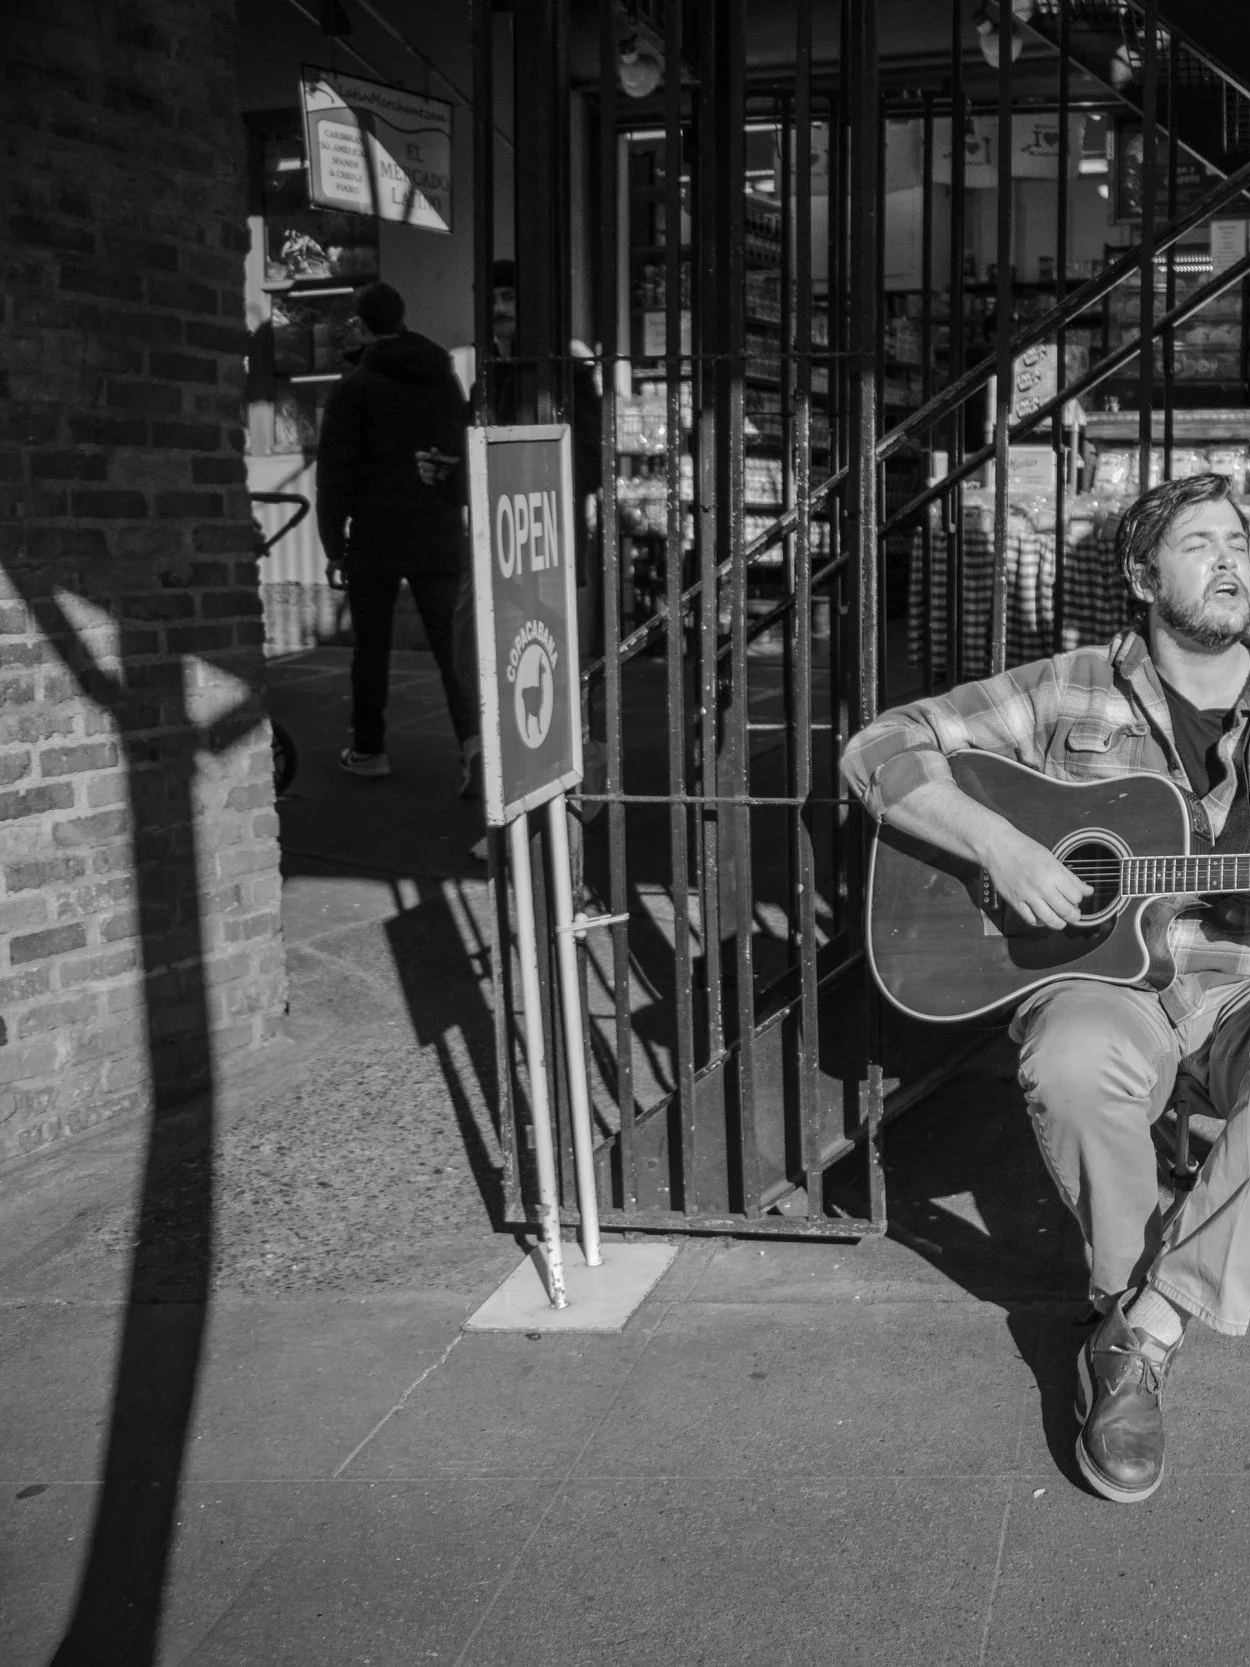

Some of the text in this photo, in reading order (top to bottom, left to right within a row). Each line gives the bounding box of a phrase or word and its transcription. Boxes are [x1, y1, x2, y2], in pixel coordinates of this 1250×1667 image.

[380, 160, 450, 190] MERCADO
[406, 143, 424, 163] EL
[497, 490, 559, 579] OPEN
[507, 619, 559, 682] COPACABANA
